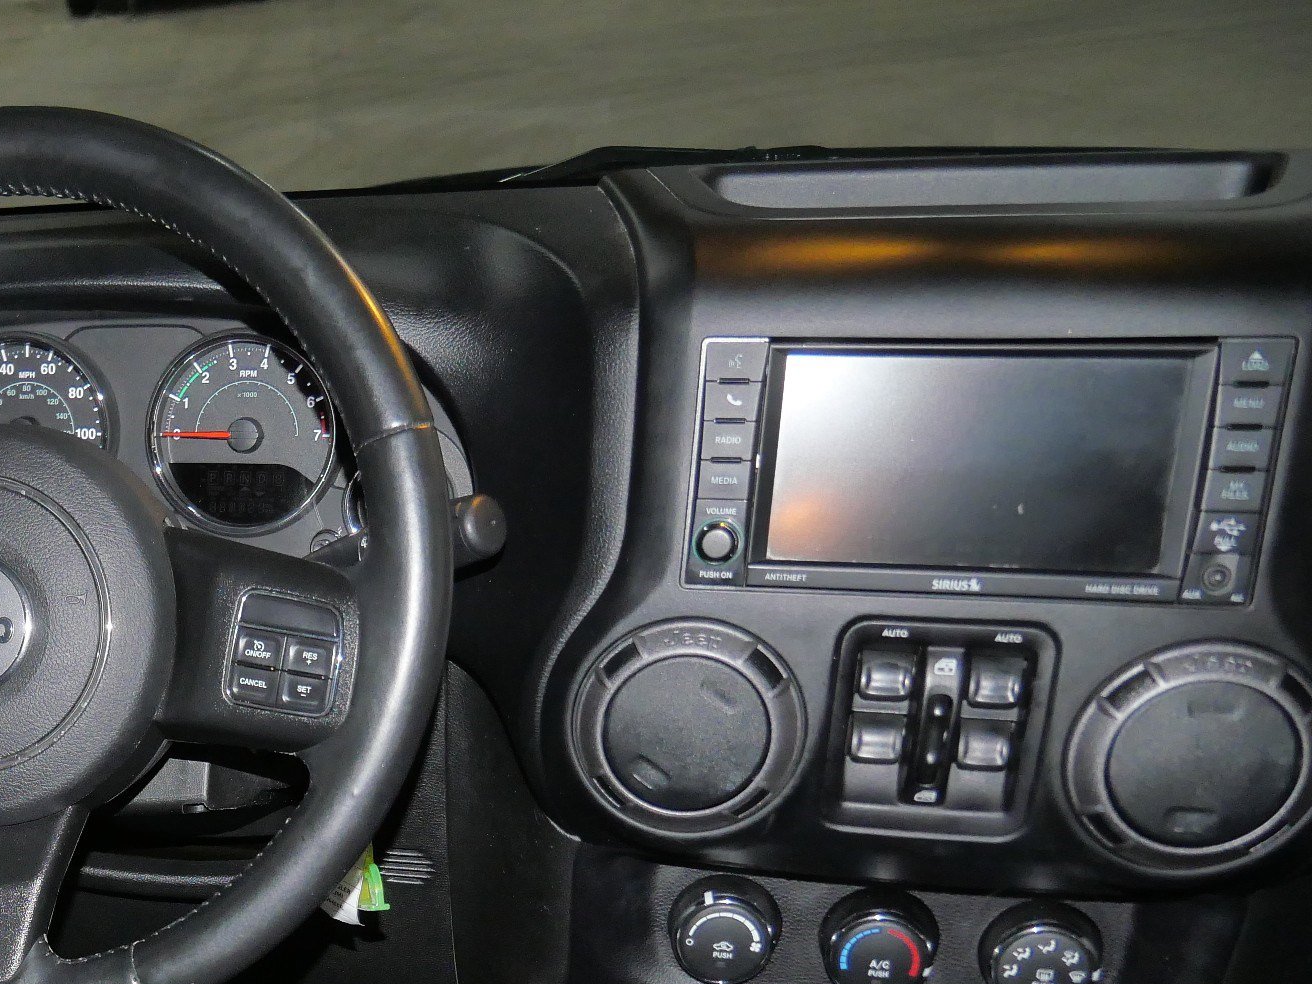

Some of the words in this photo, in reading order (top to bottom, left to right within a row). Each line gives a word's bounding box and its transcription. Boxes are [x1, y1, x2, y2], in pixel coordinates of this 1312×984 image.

[0, 364, 15, 375] 40
[40, 363, 56, 375] 60
[229, 358, 237, 370] 3
[260, 358, 269, 370] 4
[18, 371, 36, 379] MPH
[201, 372, 210, 384] 2
[239, 370, 258, 378] RPM
[287, 373, 295, 384] 5
[68, 387, 84, 399] 80
[182, 397, 189, 409] 1
[306, 397, 315, 408] 6
[56, 412, 68, 420] 140
[75, 428, 96, 440] 100
[313, 429, 322, 441] 7
[715, 436, 741, 445] RADIO
[711, 476, 738, 485] MEDIA
[706, 507, 737, 516] VOLUME
[699, 571, 720, 579] PUSH
[720, 571, 732, 579] ON
[764, 572, 807, 582] ANTITHEFT
[931, 579, 968, 591] SIRIUS
[881, 628, 909, 639] AUTO
[994, 632, 1023, 644] AUTO
[245, 649, 271, 659] ON/OFF
[302, 651, 318, 660] RES
[239, 677, 267, 689] CANCEL
[296, 685, 311, 694] SET
[712, 951, 732, 959] PUSH
[869, 959, 890, 970] A/C
[867, 969, 890, 978] PUSH
